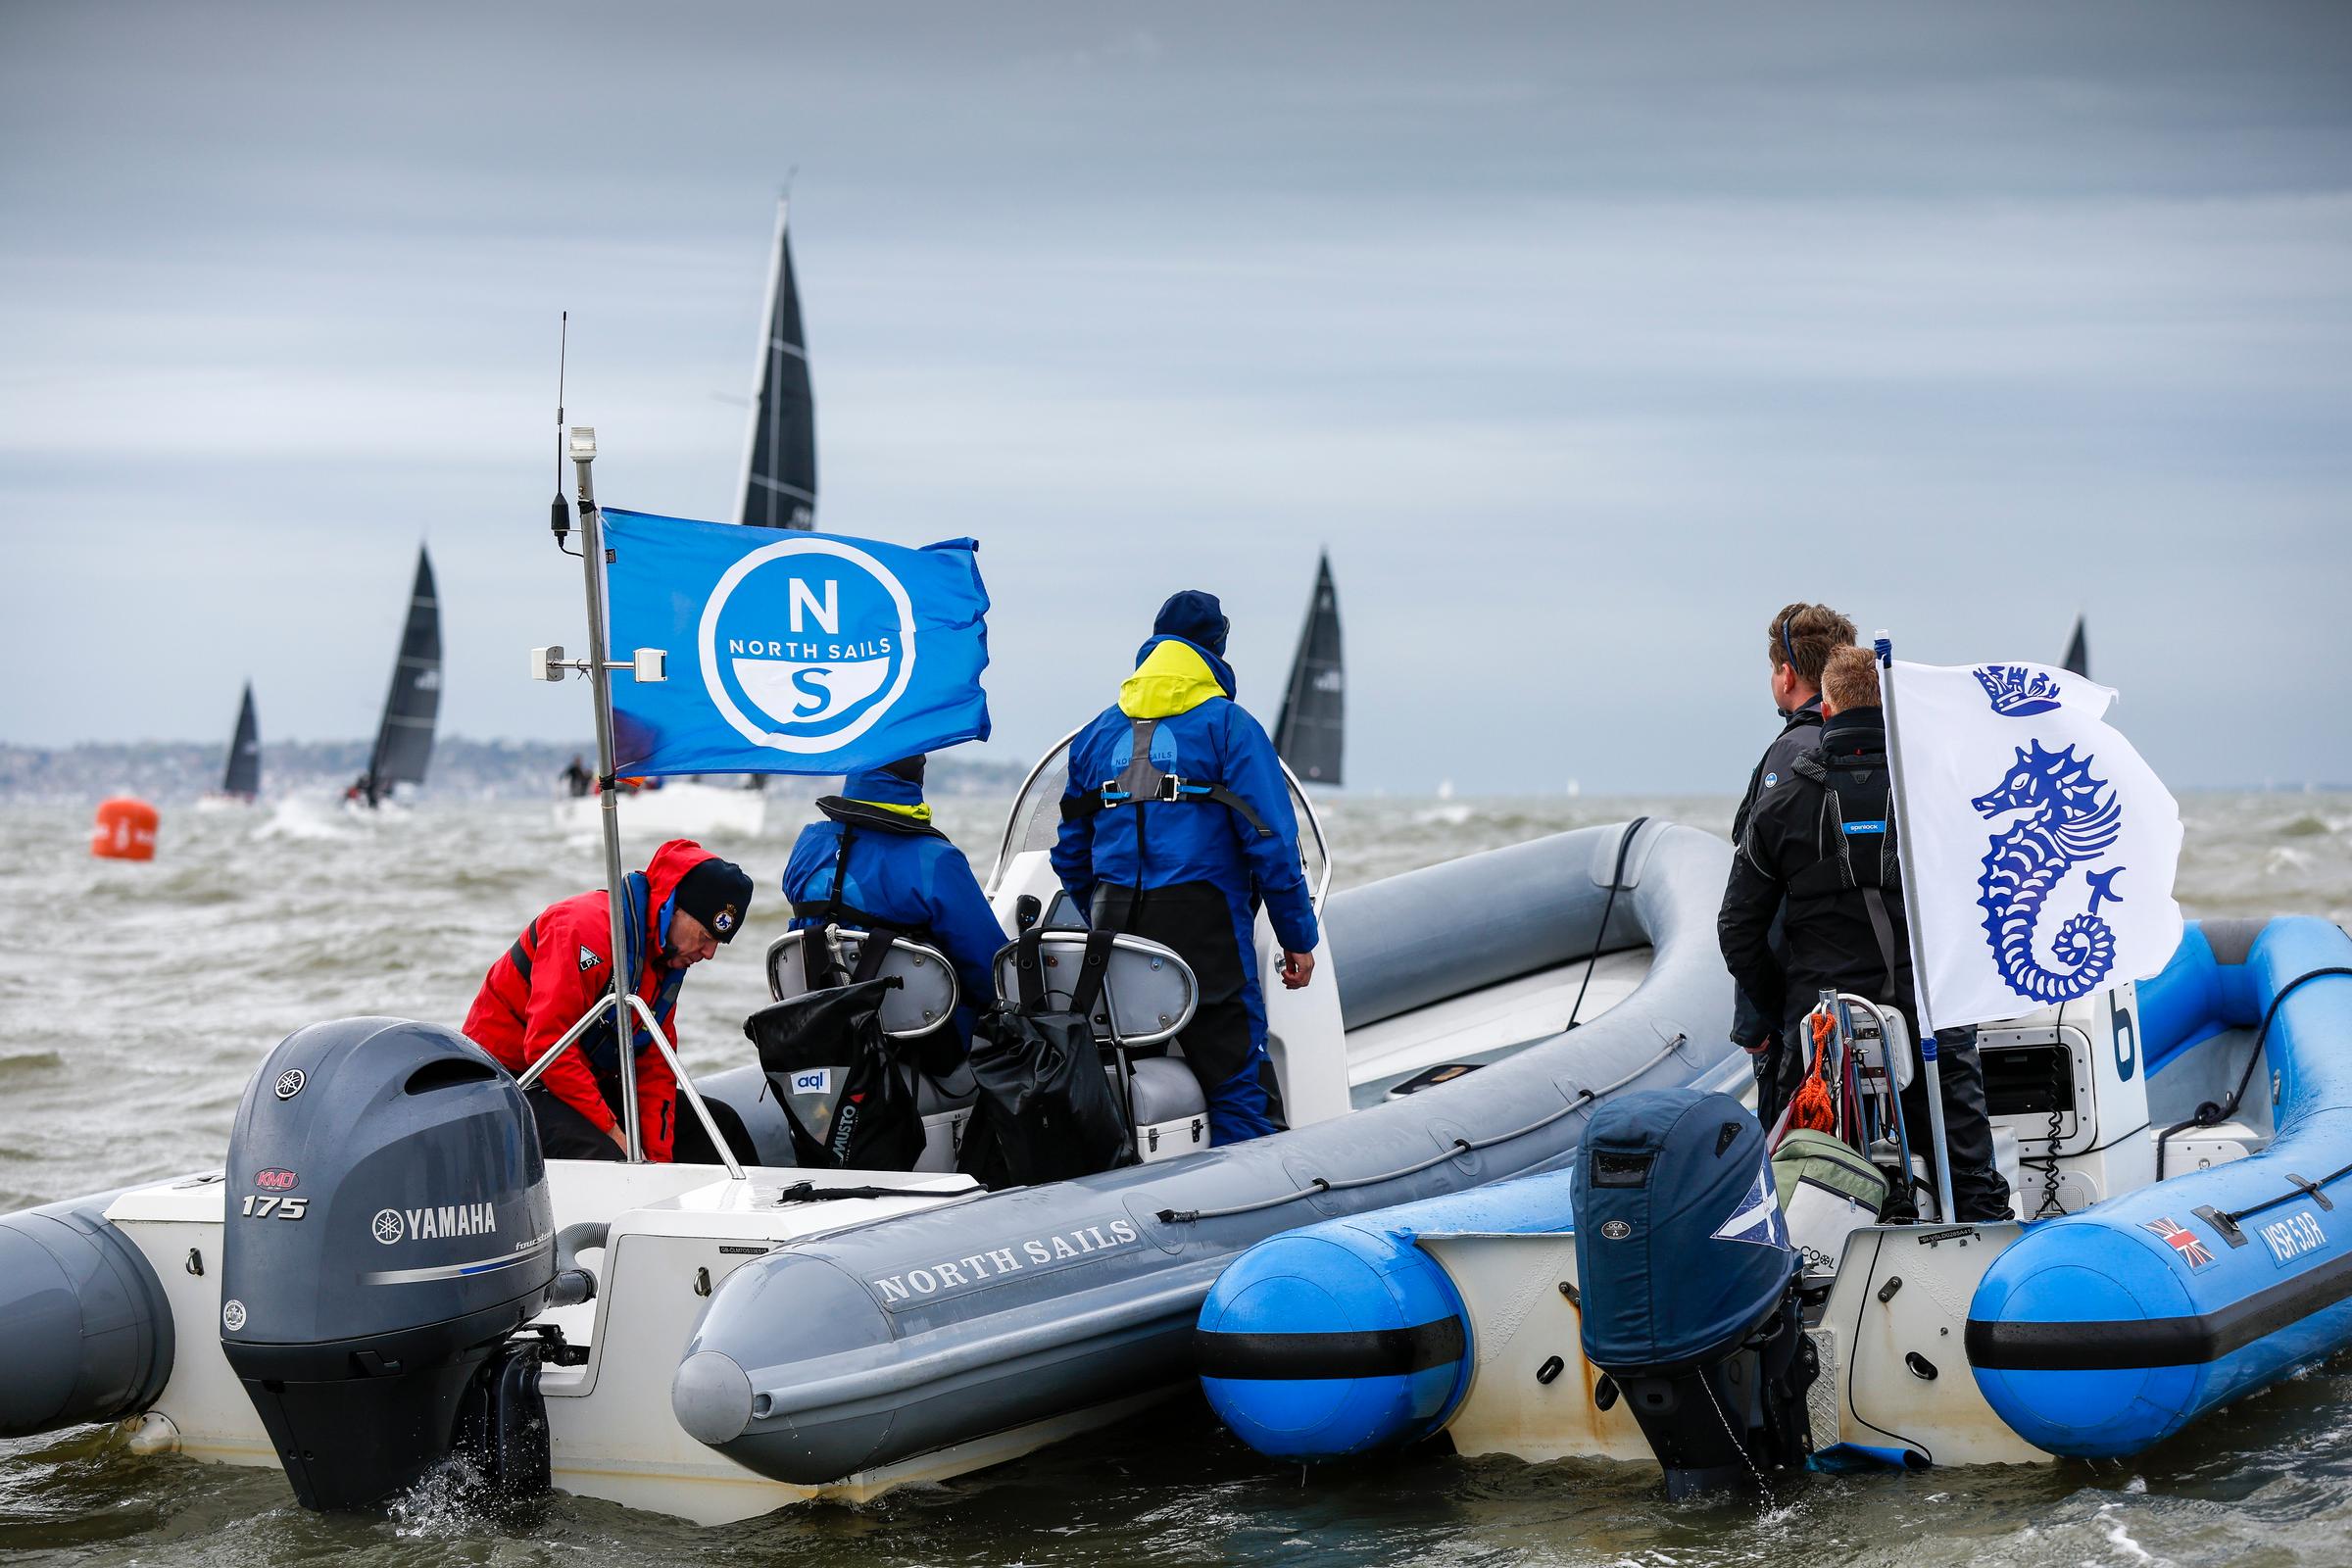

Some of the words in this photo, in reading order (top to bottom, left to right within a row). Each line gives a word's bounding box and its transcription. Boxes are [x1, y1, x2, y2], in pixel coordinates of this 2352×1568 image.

[789, 578, 839, 634] N
[729, 639, 817, 660] NORTH
[828, 638, 891, 660] SAILS
[792, 667, 833, 718] S
[580, 956, 600, 970] LPX
[798, 1072, 823, 1090] aql
[832, 1105, 857, 1162] MUSTO
[243, 1195, 310, 1220] 175
[406, 1202, 496, 1240] YAMAHA
[2260, 1222, 2301, 1261] VSR
[2286, 1211, 2328, 1251] 5.8R
[873, 1247, 1023, 1302] NORTH
[1023, 1219, 1137, 1264] SAILS
